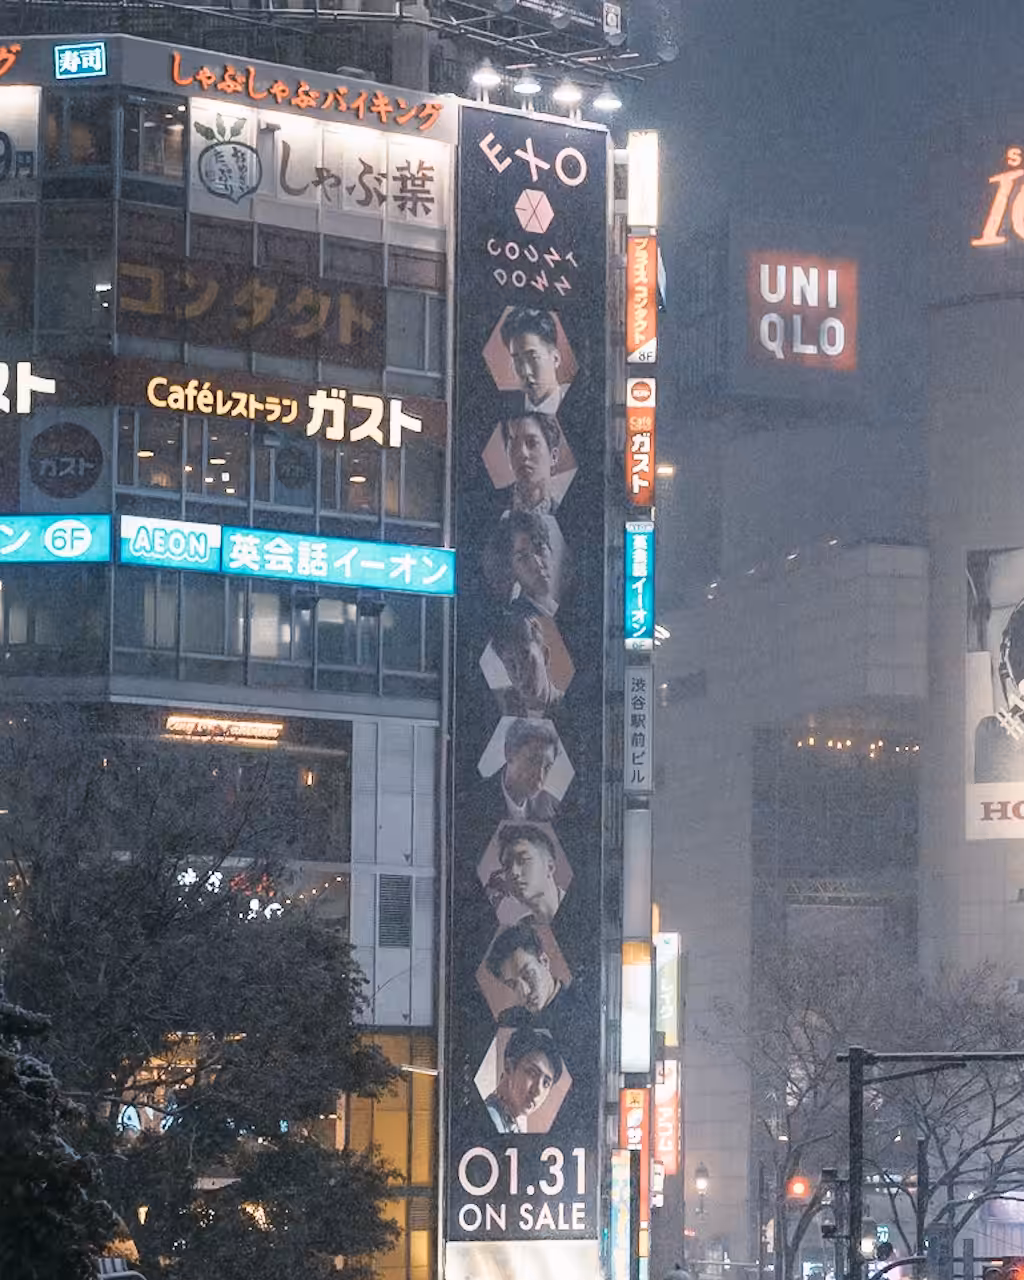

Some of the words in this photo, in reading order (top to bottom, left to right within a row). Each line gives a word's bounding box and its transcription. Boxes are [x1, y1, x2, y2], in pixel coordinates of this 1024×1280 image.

[60, 48, 103, 73] 寿司
[172, 51, 443, 130] しゃぶしゃぶバイキング
[280, 140, 434, 217] しゃぶ葉
[479, 132, 587, 187] EXO
[487, 239, 578, 268] COUNT
[119, 262, 374, 344] コンタクト
[493, 269, 572, 296] DOWN
[760, 264, 837, 308] UNI
[760, 312, 845, 359] QLO
[0, 361, 56, 413] ト
[306, 388, 423, 448] ガスト
[39, 456, 95, 477] ガスト
[631, 432, 651, 494] ガスト
[51, 528, 86, 550] 6F
[133, 526, 209, 560] AEON
[229, 533, 449, 586] 英会話イーオン
[631, 677, 646, 783] 渋谷駅前ビル
[458, 1147, 586, 1195] 01.31
[458, 1203, 506, 1231] ON
[519, 1202, 586, 1231] SALE
